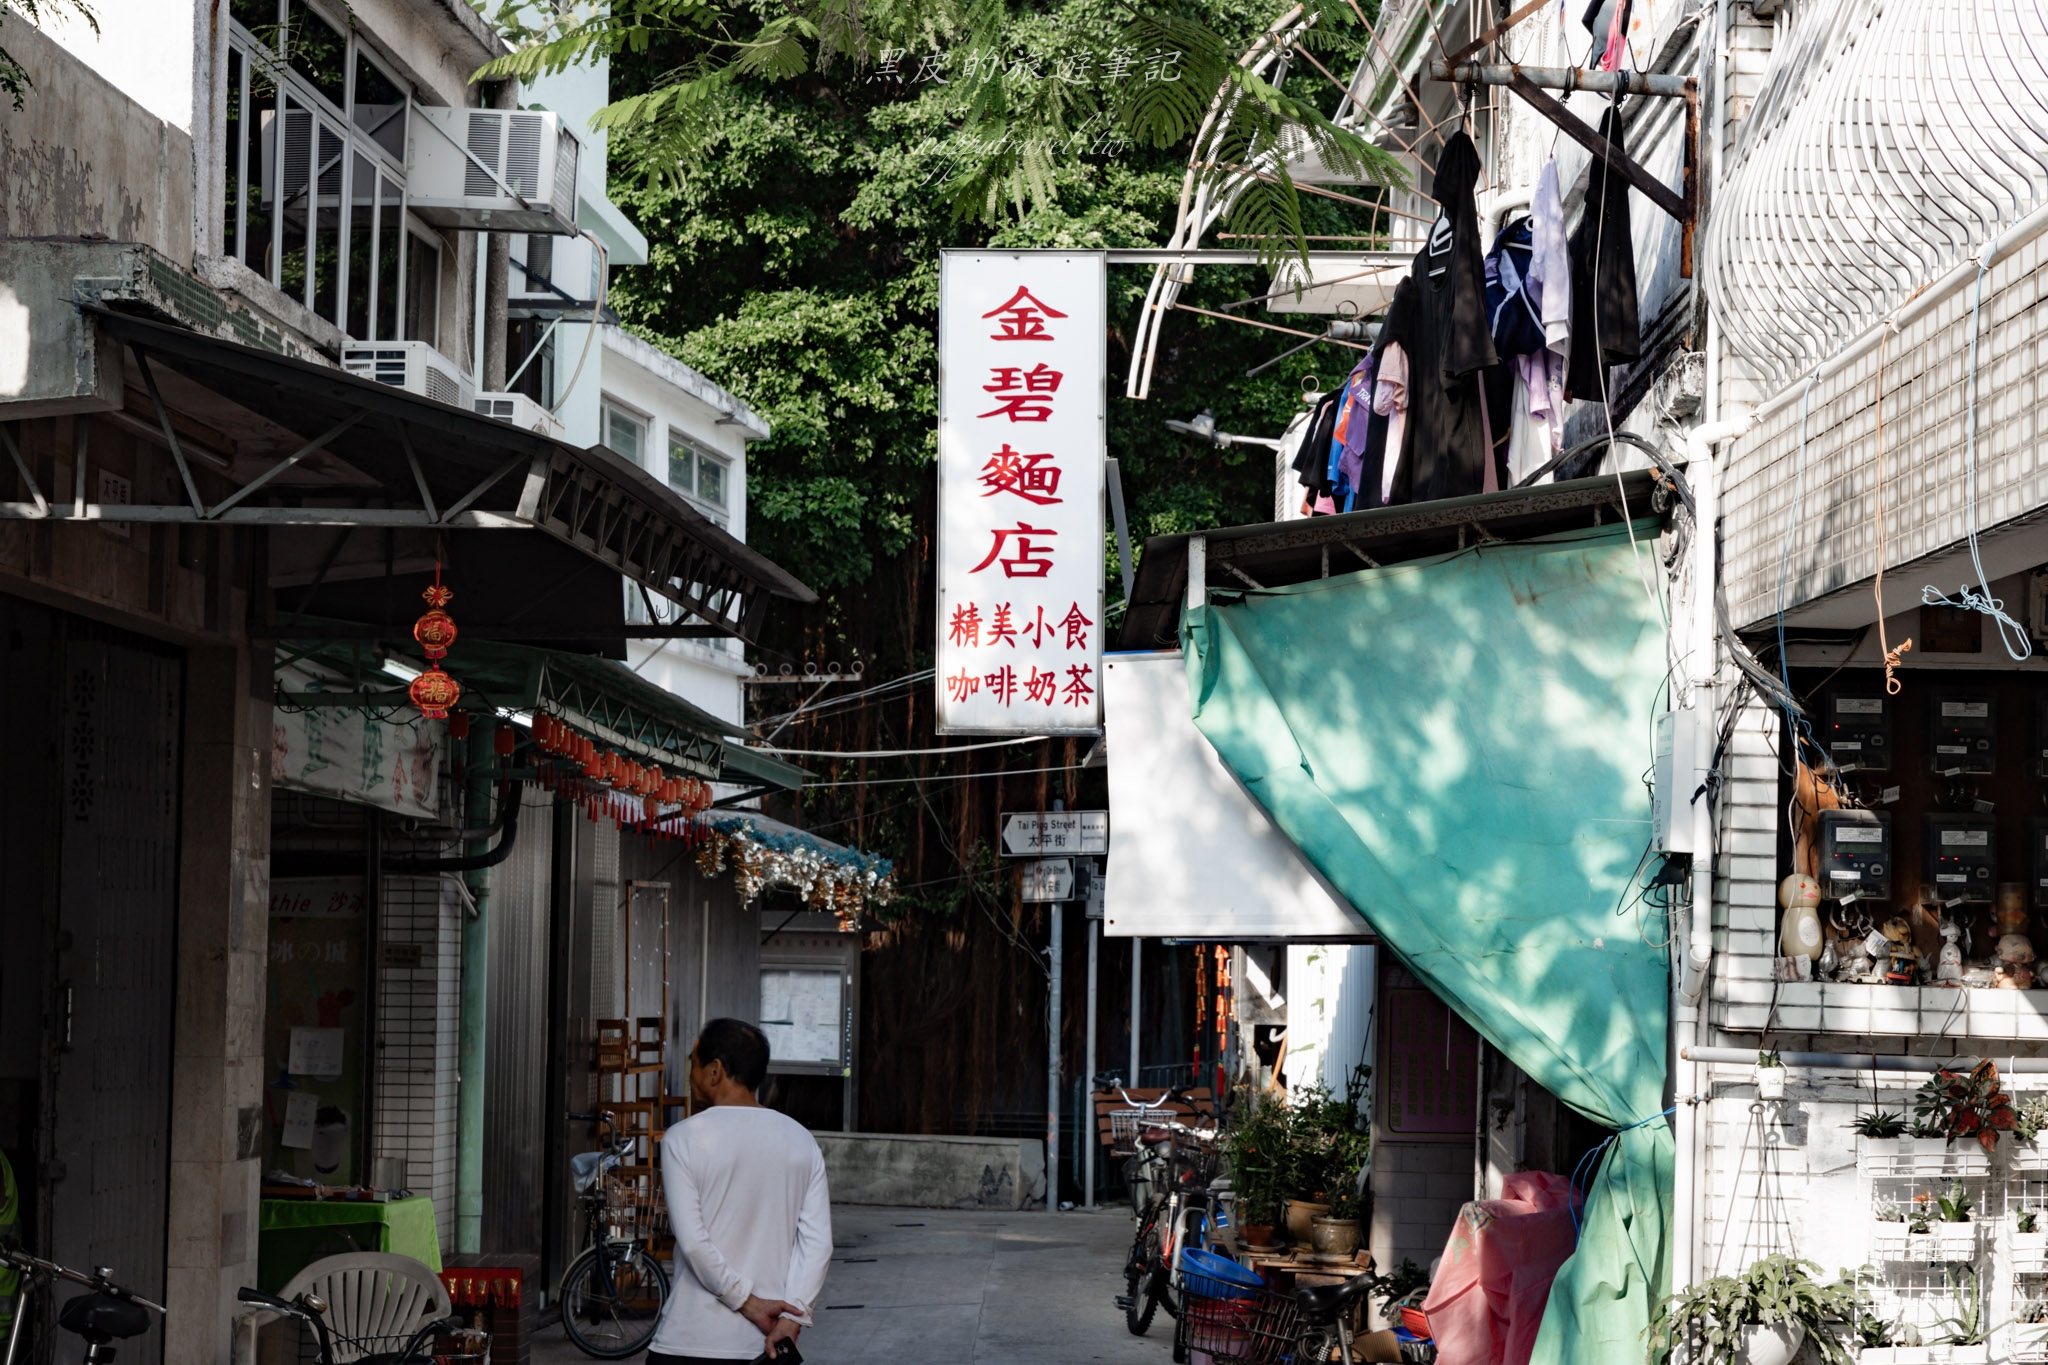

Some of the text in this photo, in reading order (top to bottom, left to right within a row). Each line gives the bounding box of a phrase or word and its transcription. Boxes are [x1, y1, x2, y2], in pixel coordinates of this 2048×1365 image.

[968, 285, 1068, 579] 金碧麵店
[949, 601, 1094, 650] 精美小食
[947, 663, 1094, 708] 咖啡奶茶
[1018, 821, 1029, 830] Tai
[1051, 819, 1076, 830] Street
[1028, 834, 1066, 848] 太平街
